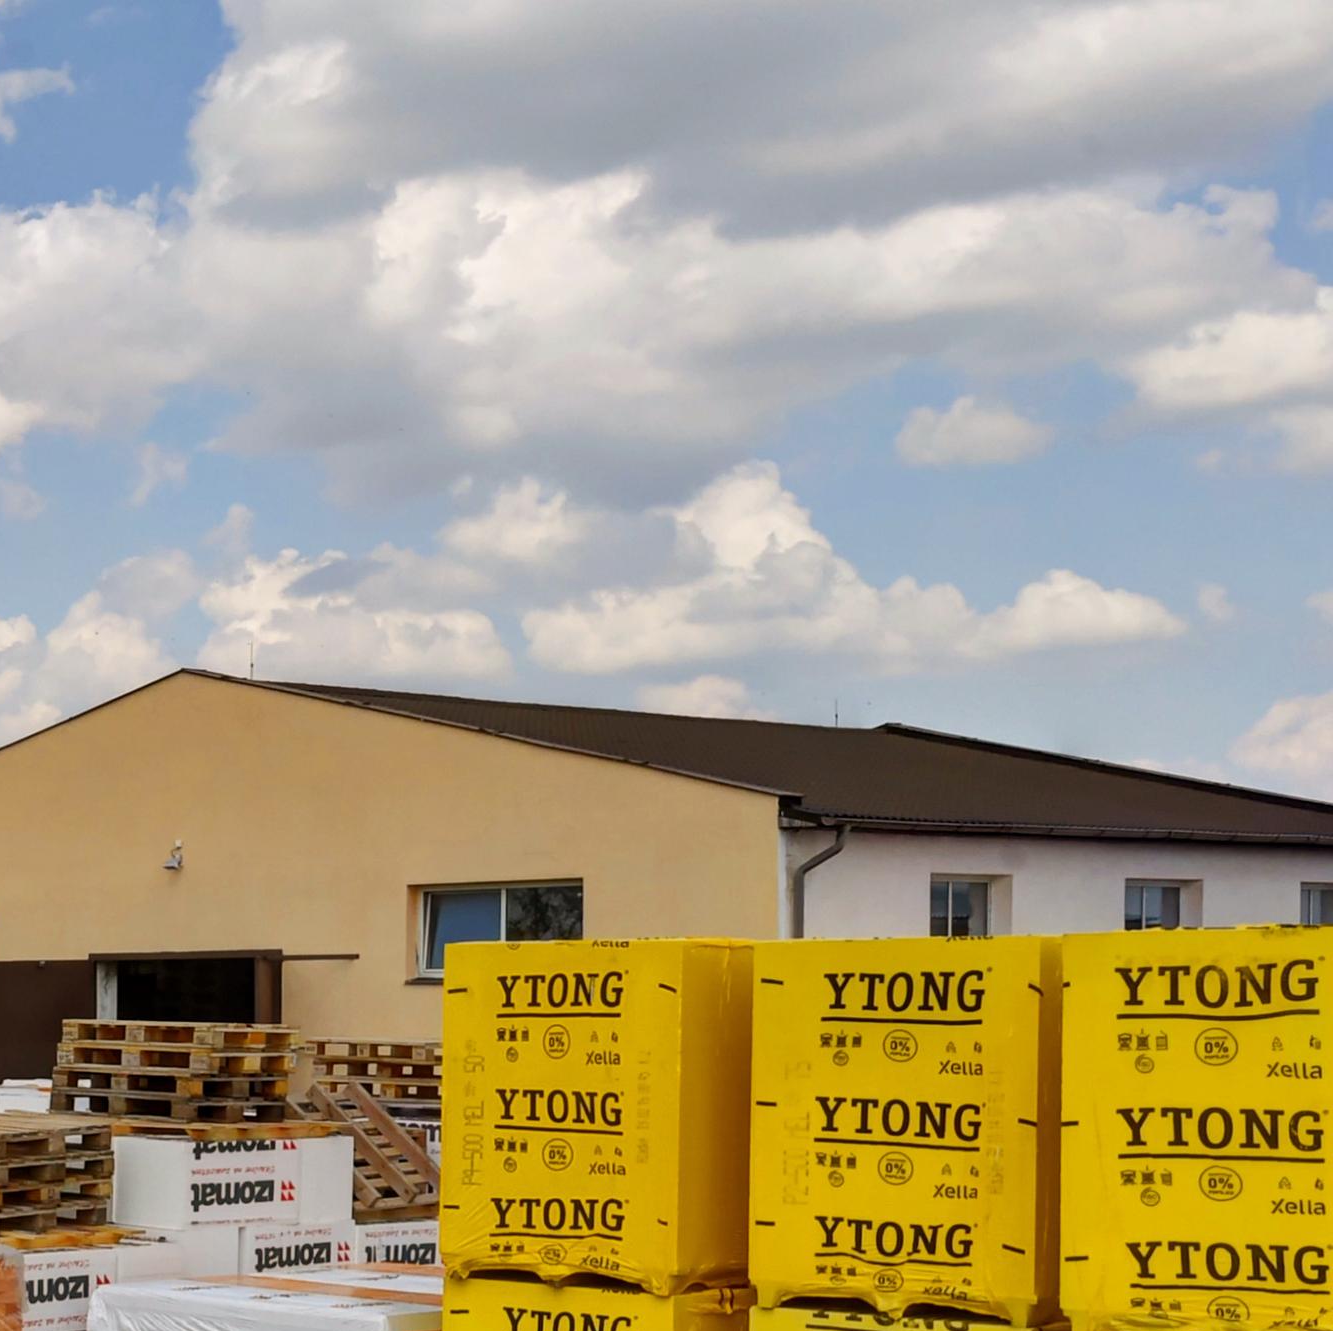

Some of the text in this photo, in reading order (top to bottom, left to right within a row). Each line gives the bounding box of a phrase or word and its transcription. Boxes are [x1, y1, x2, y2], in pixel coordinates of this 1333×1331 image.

[497, 971, 624, 1008] YTONG
[824, 970, 985, 1012] YTONG
[1114, 959, 1319, 1008] YTONG
[549, 1036, 565, 1048] 0%
[890, 1040, 910, 1052] 0%
[1204, 1041, 1229, 1054] 0%
[585, 1050, 621, 1065] Xella
[938, 1060, 983, 1076] Xella
[1266, 1062, 1323, 1080] Xella
[496, 1089, 623, 1126] YTONG
[815, 1096, 982, 1142] YTONG
[1116, 1107, 1324, 1152] YTONG
[549, 1149, 566, 1160] 0%
[589, 1162, 626, 1176] Xella
[885, 1163, 906, 1175] 0%
[933, 1184, 978, 1199] Xella
[1208, 1176, 1234, 1189] 0%
[191, 1179, 276, 1212] izomat
[490, 1197, 625, 1231] YTONG
[1271, 1198, 1326, 1216] Xella
[814, 1215, 974, 1259] YTONG
[255, 1241, 332, 1271] izomat
[581, 1254, 621, 1271] Xella
[1125, 1241, 1329, 1285] YTONG
[26, 1274, 90, 1304] izom
